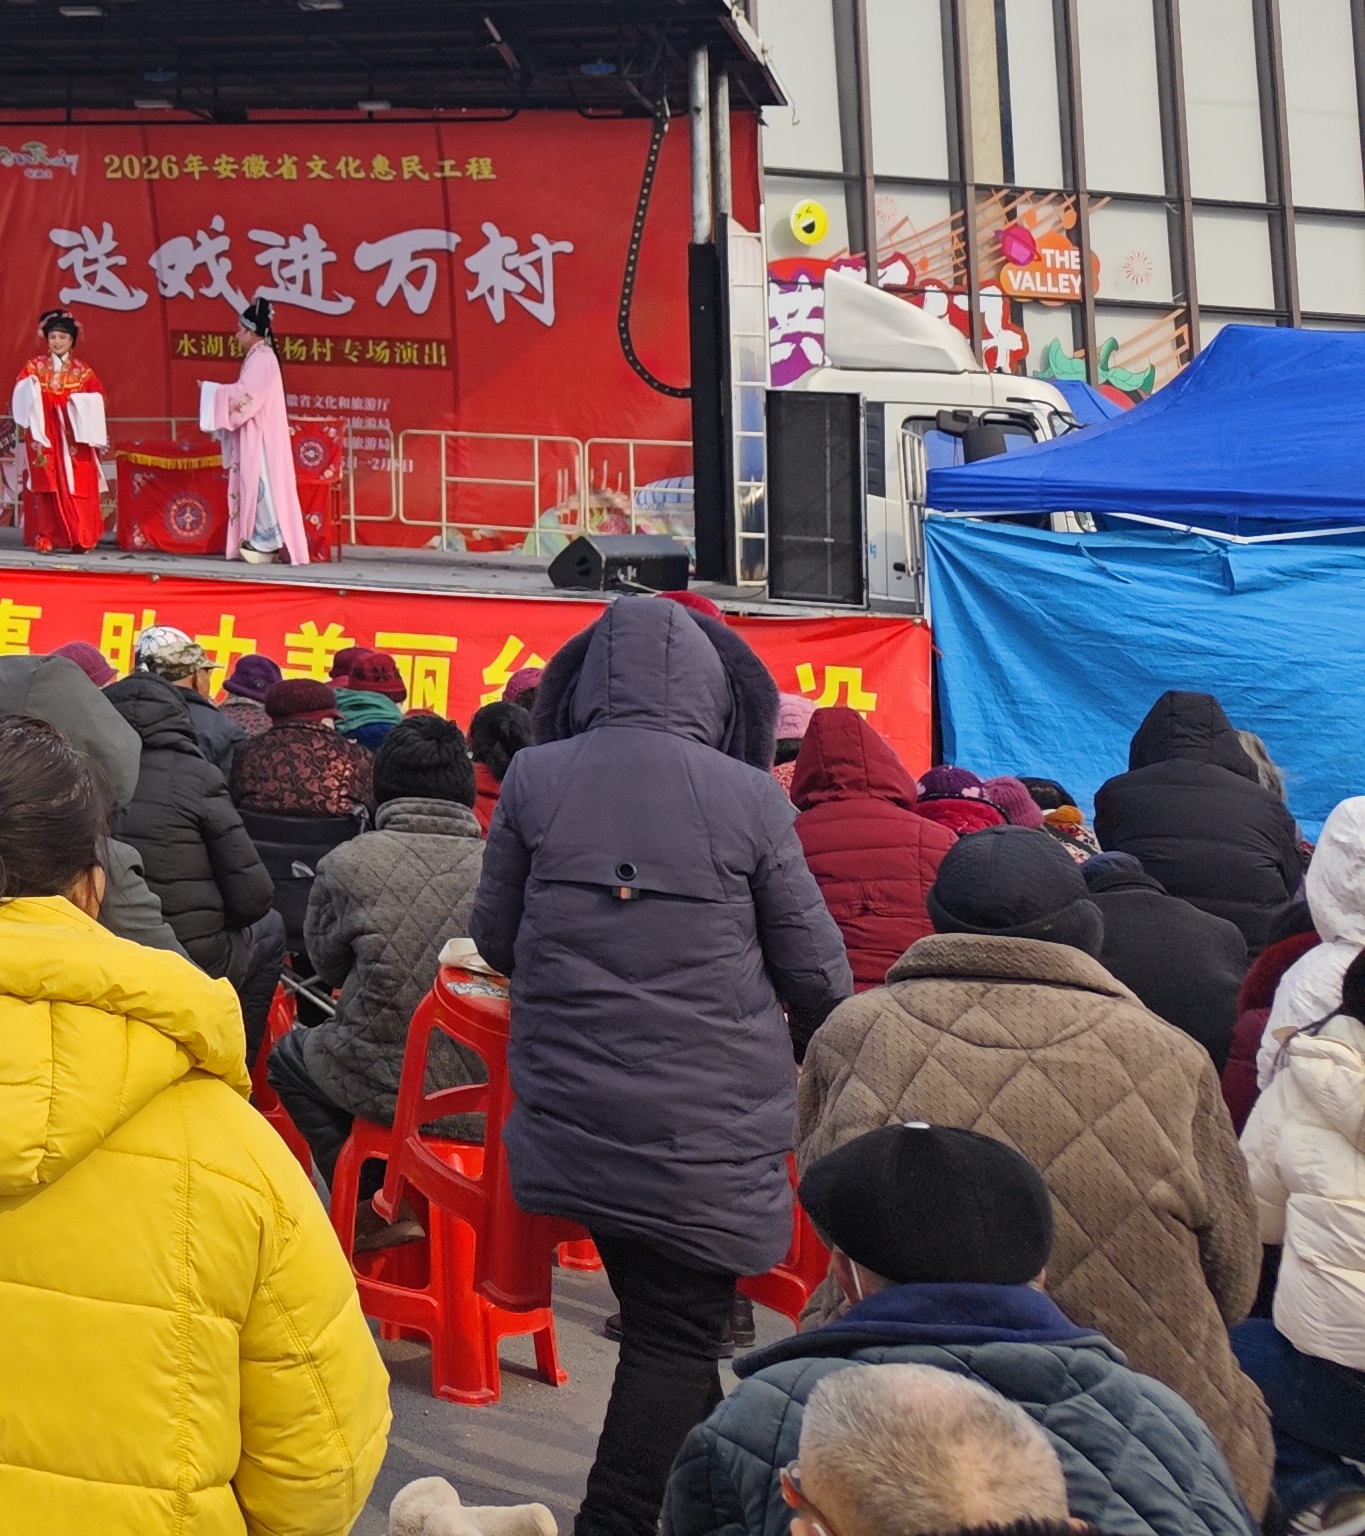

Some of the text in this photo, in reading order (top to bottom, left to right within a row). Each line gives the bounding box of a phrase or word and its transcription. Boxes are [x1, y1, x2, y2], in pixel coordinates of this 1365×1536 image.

[103, 153, 498, 181] 2026年安徽省文化惠民工程
[48, 214, 574, 327] 送戏进万村
[1041, 248, 1081, 270] THE
[1007, 273, 1082, 295] VALLEY
[175, 332, 447, 367] 水湖镇杨村专场演出
